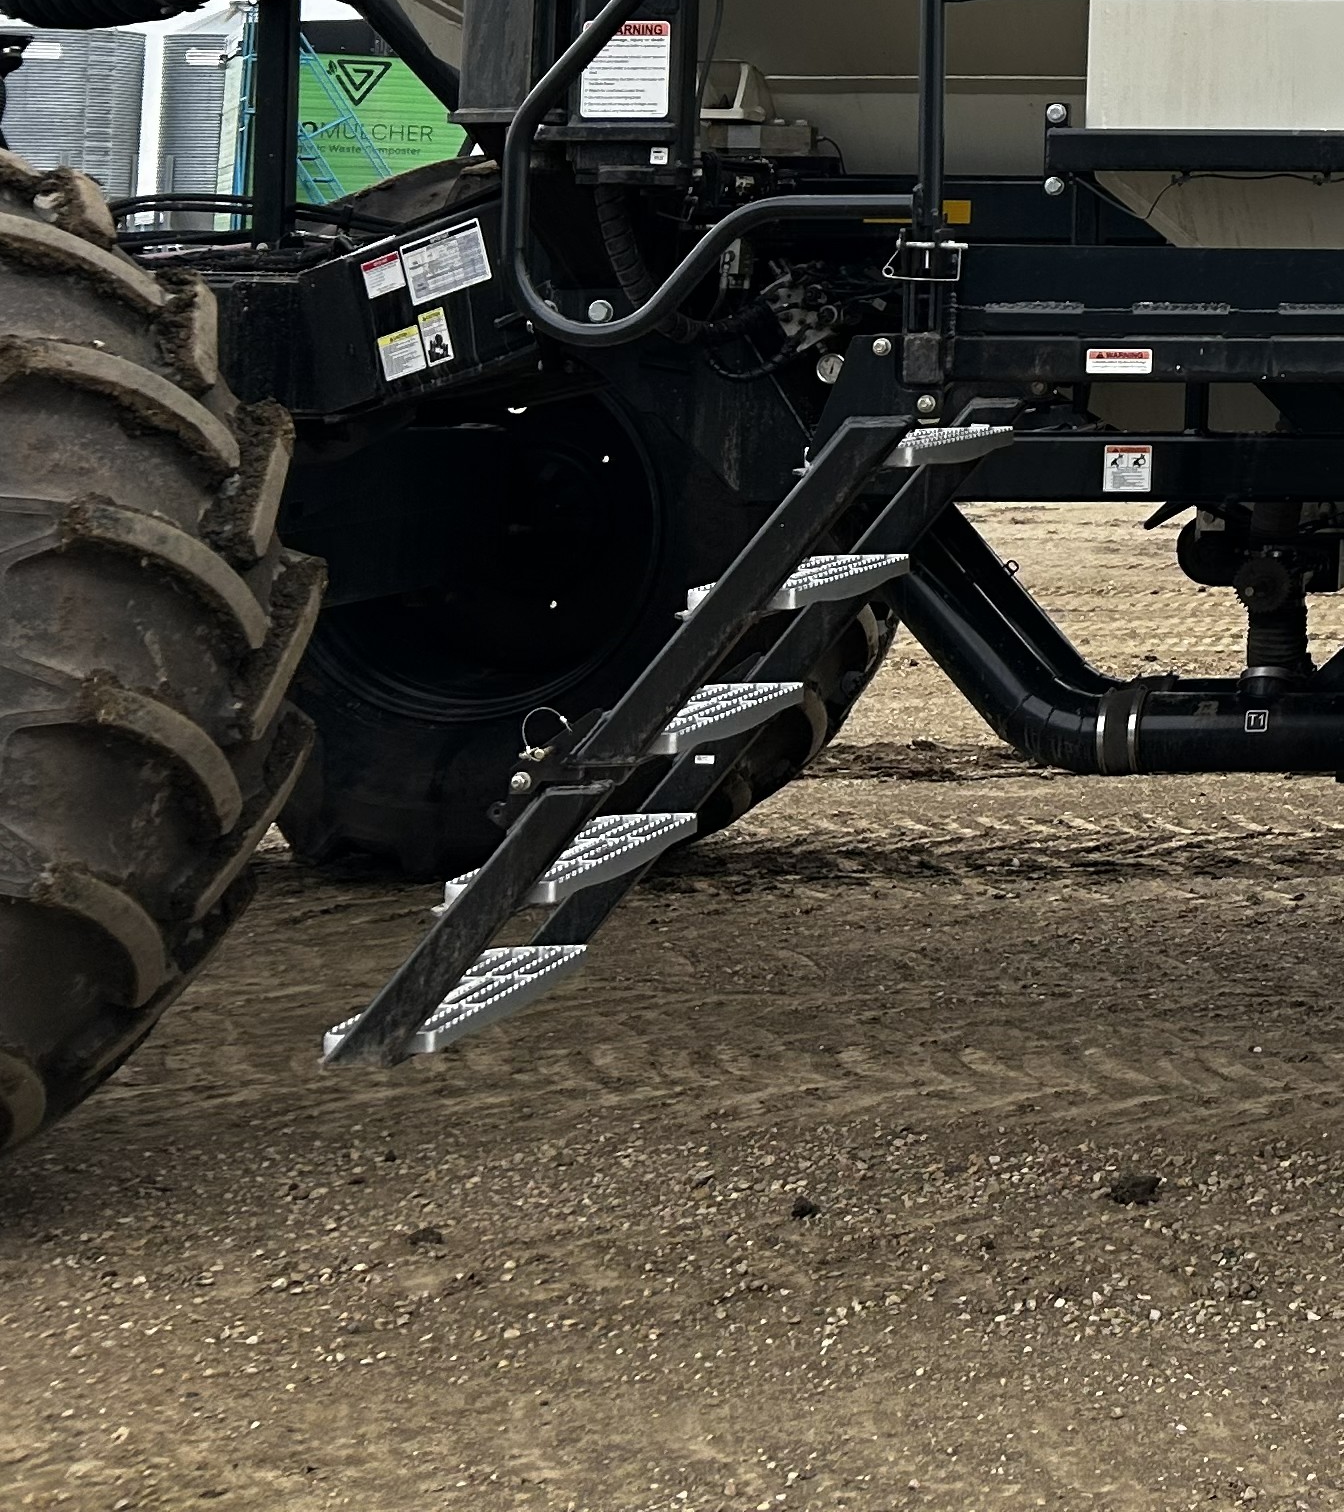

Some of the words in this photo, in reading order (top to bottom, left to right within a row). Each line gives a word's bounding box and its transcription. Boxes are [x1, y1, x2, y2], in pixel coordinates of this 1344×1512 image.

[615, 24, 663, 35] ARNING
[1106, 351, 1144, 359] WARNING
[1248, 713, 1265, 727] T1
